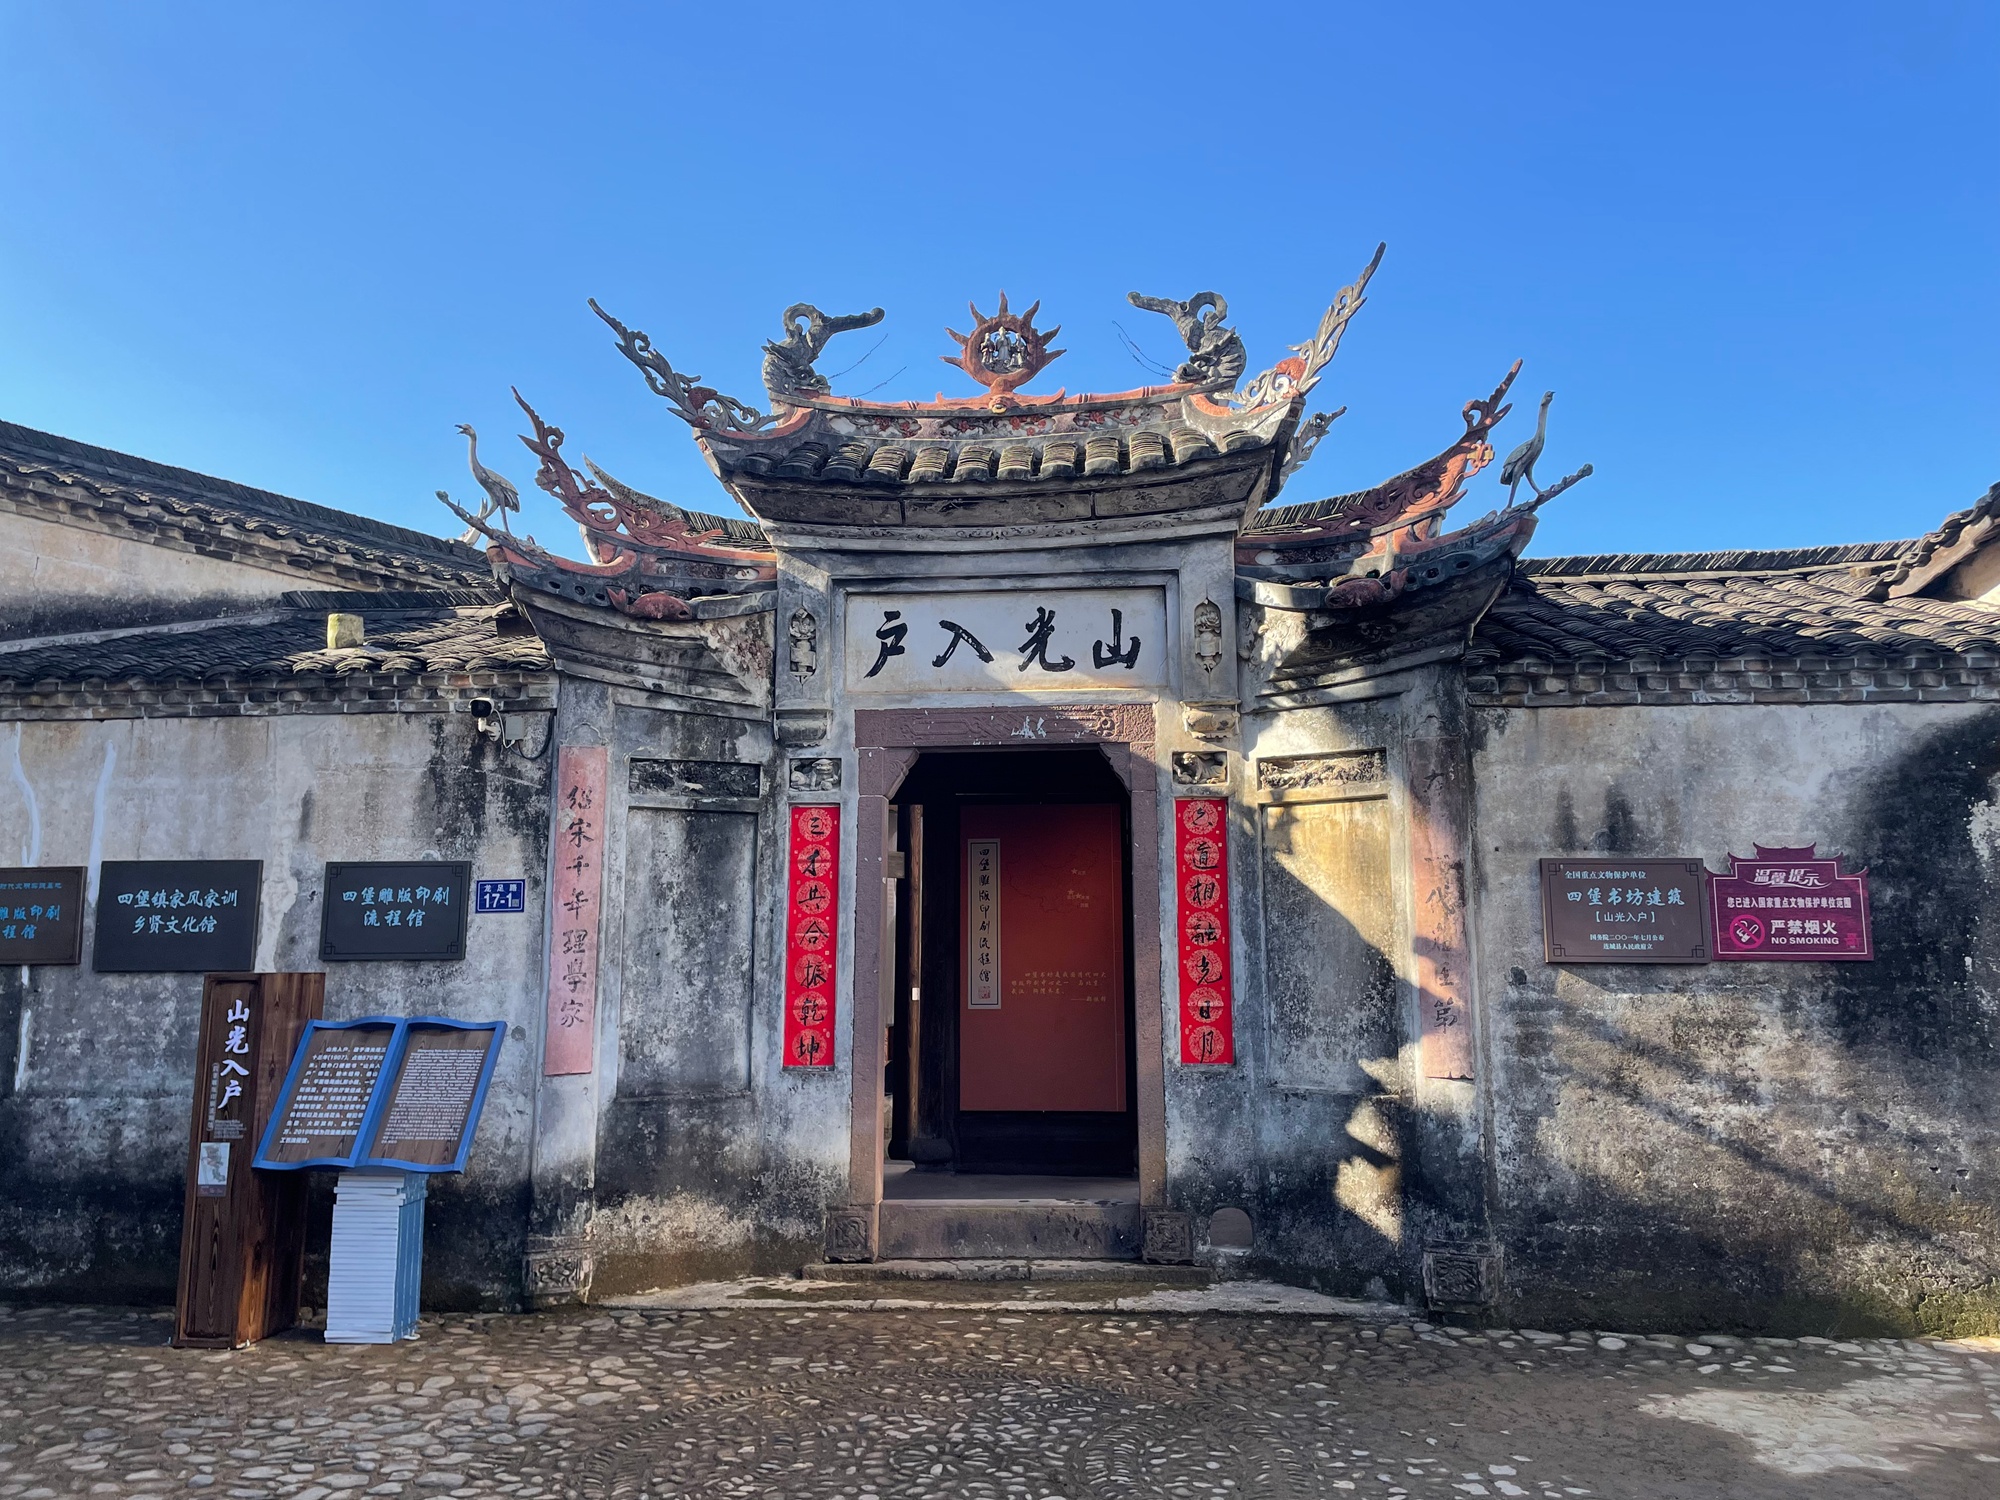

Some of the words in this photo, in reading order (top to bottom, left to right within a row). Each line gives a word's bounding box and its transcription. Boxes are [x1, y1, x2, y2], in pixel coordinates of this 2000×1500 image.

[864, 606, 1141, 679] 山光入户
[1564, 870, 1647, 880] 全国重点文物保护单位
[1753, 868, 1825, 887] 温馨提示
[117, 888, 238, 909] 四堡镇家风家训
[342, 885, 450, 906] 四堡雕版印刷
[484, 892, 512, 908] 17-1
[1566, 886, 1685, 906] 四堡书坊建筑
[1727, 896, 1852, 909] 您已进入国家重点文物保护单位范围
[132, 914, 218, 934] 乡贤文化馆
[363, 908, 426, 927] 流程馆
[1770, 919, 1838, 935] 严禁烟火
[1771, 937, 1787, 945] NO
[1789, 936, 1840, 945] SMOKING
[217, 998, 250, 1110] 山光入户
